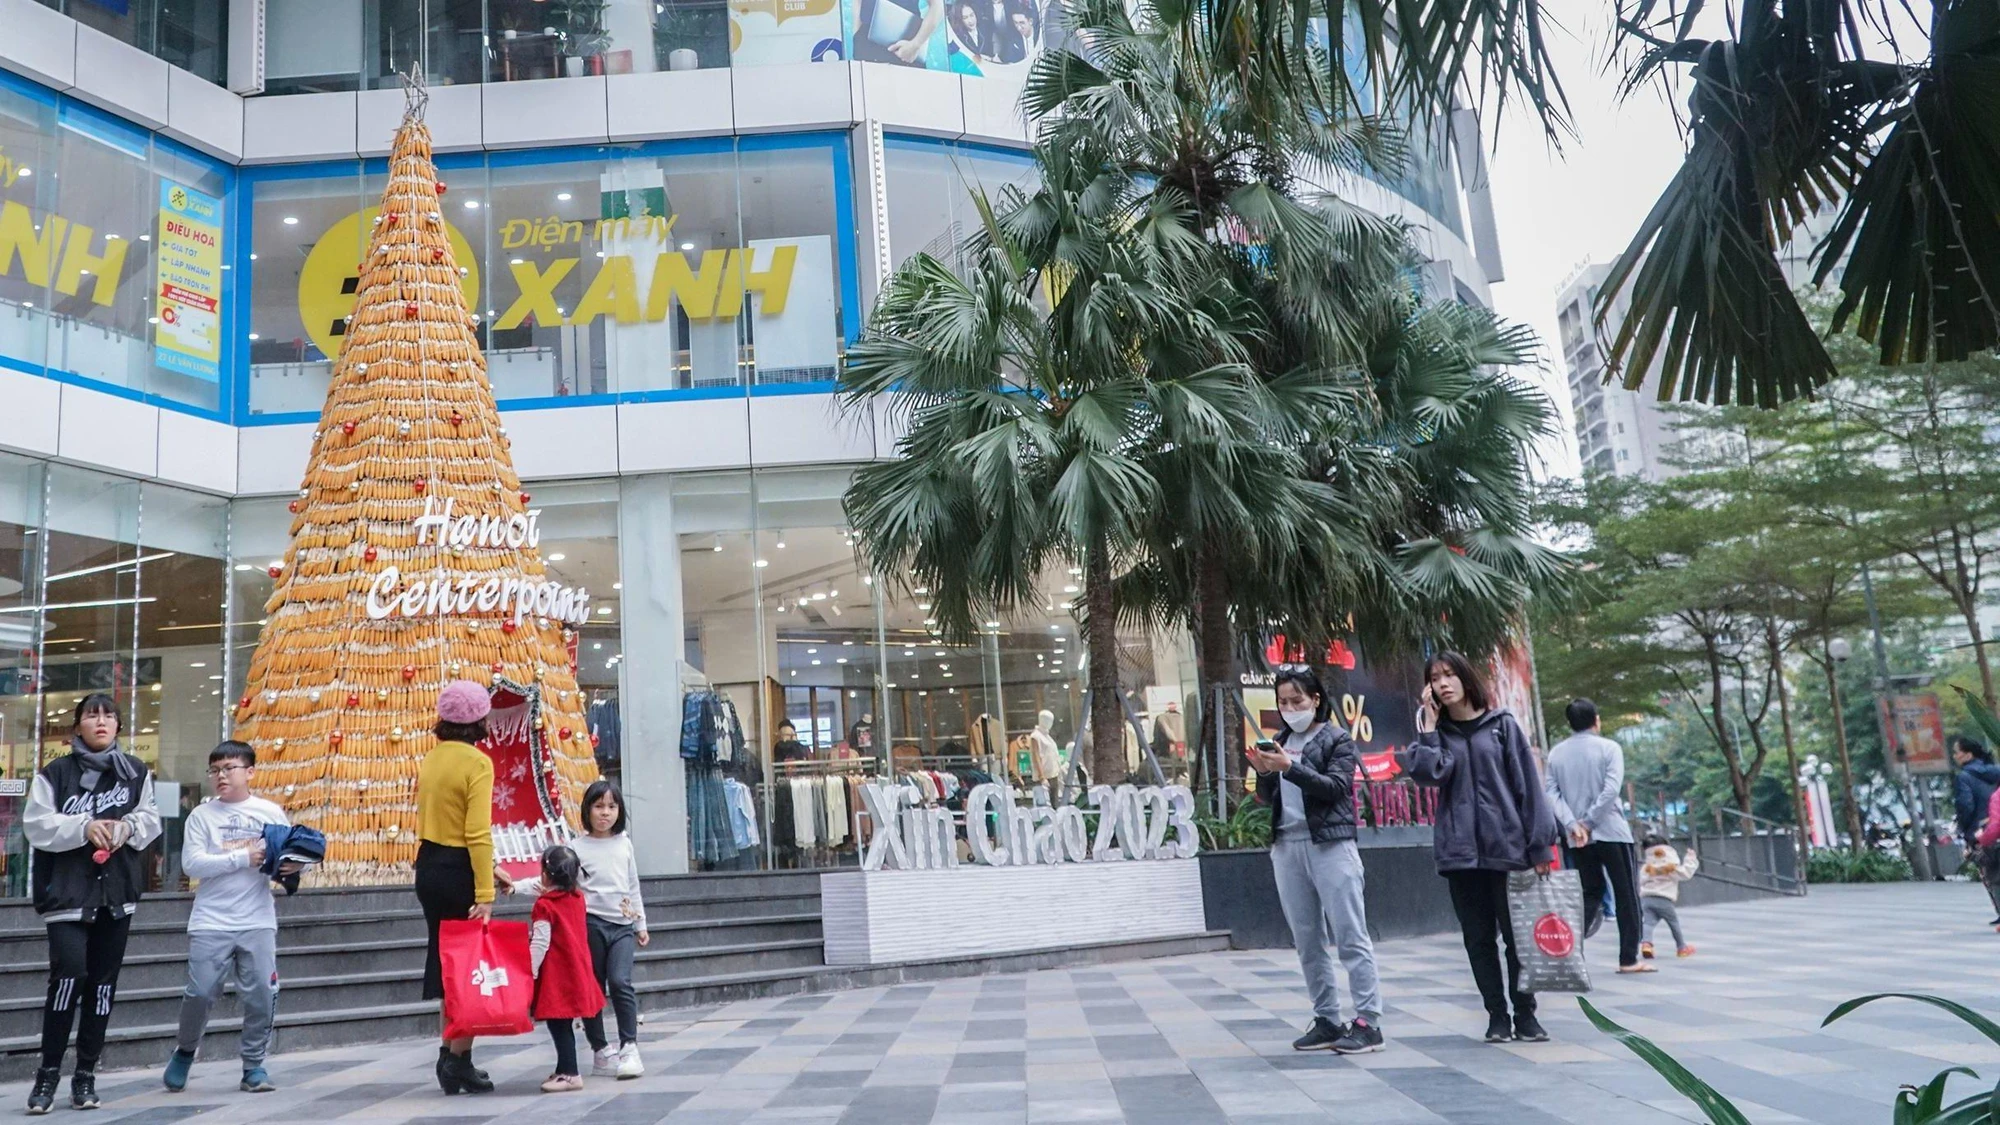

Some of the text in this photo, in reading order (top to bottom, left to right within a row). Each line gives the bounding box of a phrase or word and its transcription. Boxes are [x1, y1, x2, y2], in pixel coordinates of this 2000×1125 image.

[784, 2, 806, 11] CLUB
[498, 208, 679, 252] Điện máy
[491, 245, 798, 331] XANH
[366, 565, 591, 627] Centerpoint
[859, 783, 958, 870] Xin
[1087, 784, 1199, 863] 2023
